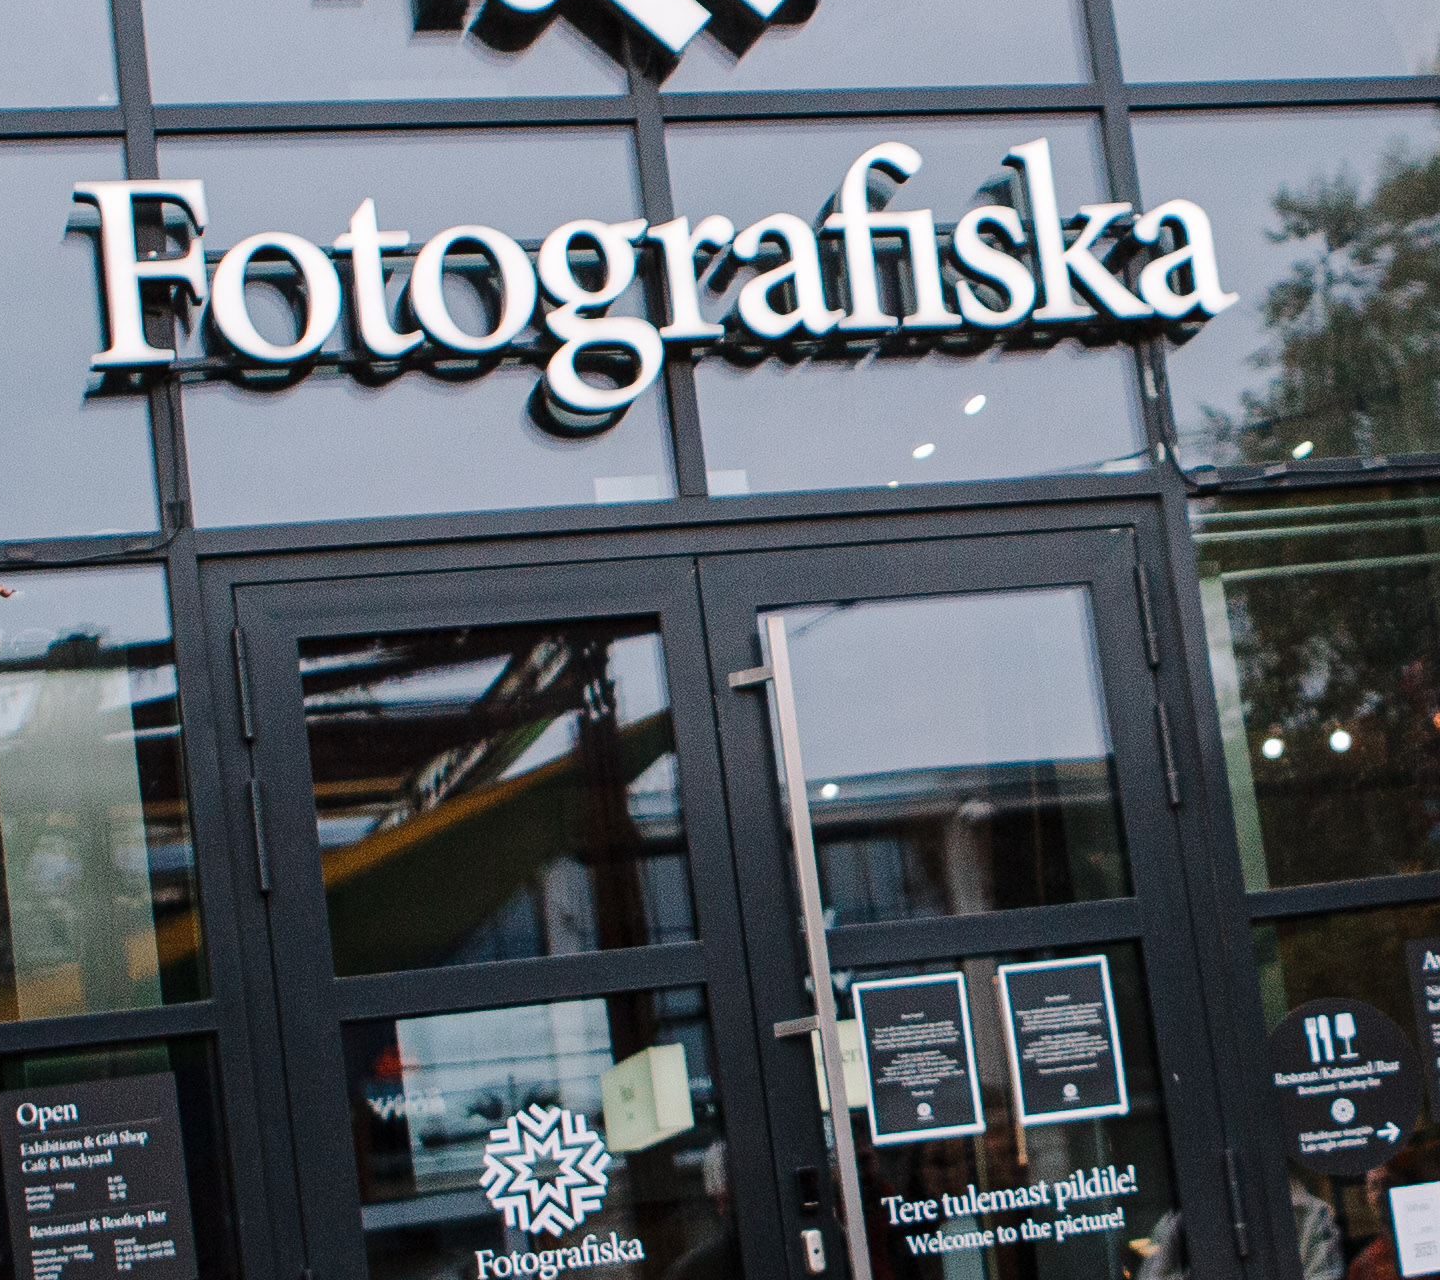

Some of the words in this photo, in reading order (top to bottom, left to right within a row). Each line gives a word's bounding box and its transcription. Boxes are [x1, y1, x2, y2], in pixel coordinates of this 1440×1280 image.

[73, 137, 1238, 414] Fotografiska
[16, 1102, 79, 1132] Open
[20, 1139, 83, 1157] Exhibitions
[83, 1135, 95, 1149] &
[96, 1131, 119, 1147] Gift
[119, 1129, 149, 1147] Shop
[50, 1156, 61, 1170] &
[62, 1149, 114, 1169] Backyard
[881, 1195, 938, 1225] Tere
[941, 1180, 1051, 1218] tulemast
[1054, 1164, 1139, 1211] pildile!
[29, 1221, 88, 1239] Restaurant
[89, 1218, 101, 1232] &
[102, 1212, 147, 1229] Rooftop
[147, 1210, 167, 1223] Bar
[906, 1230, 995, 1255] Welcome
[997, 1225, 1017, 1244] to
[1021, 1219, 1052, 1241] the
[1055, 1206, 1126, 1242] picture!
